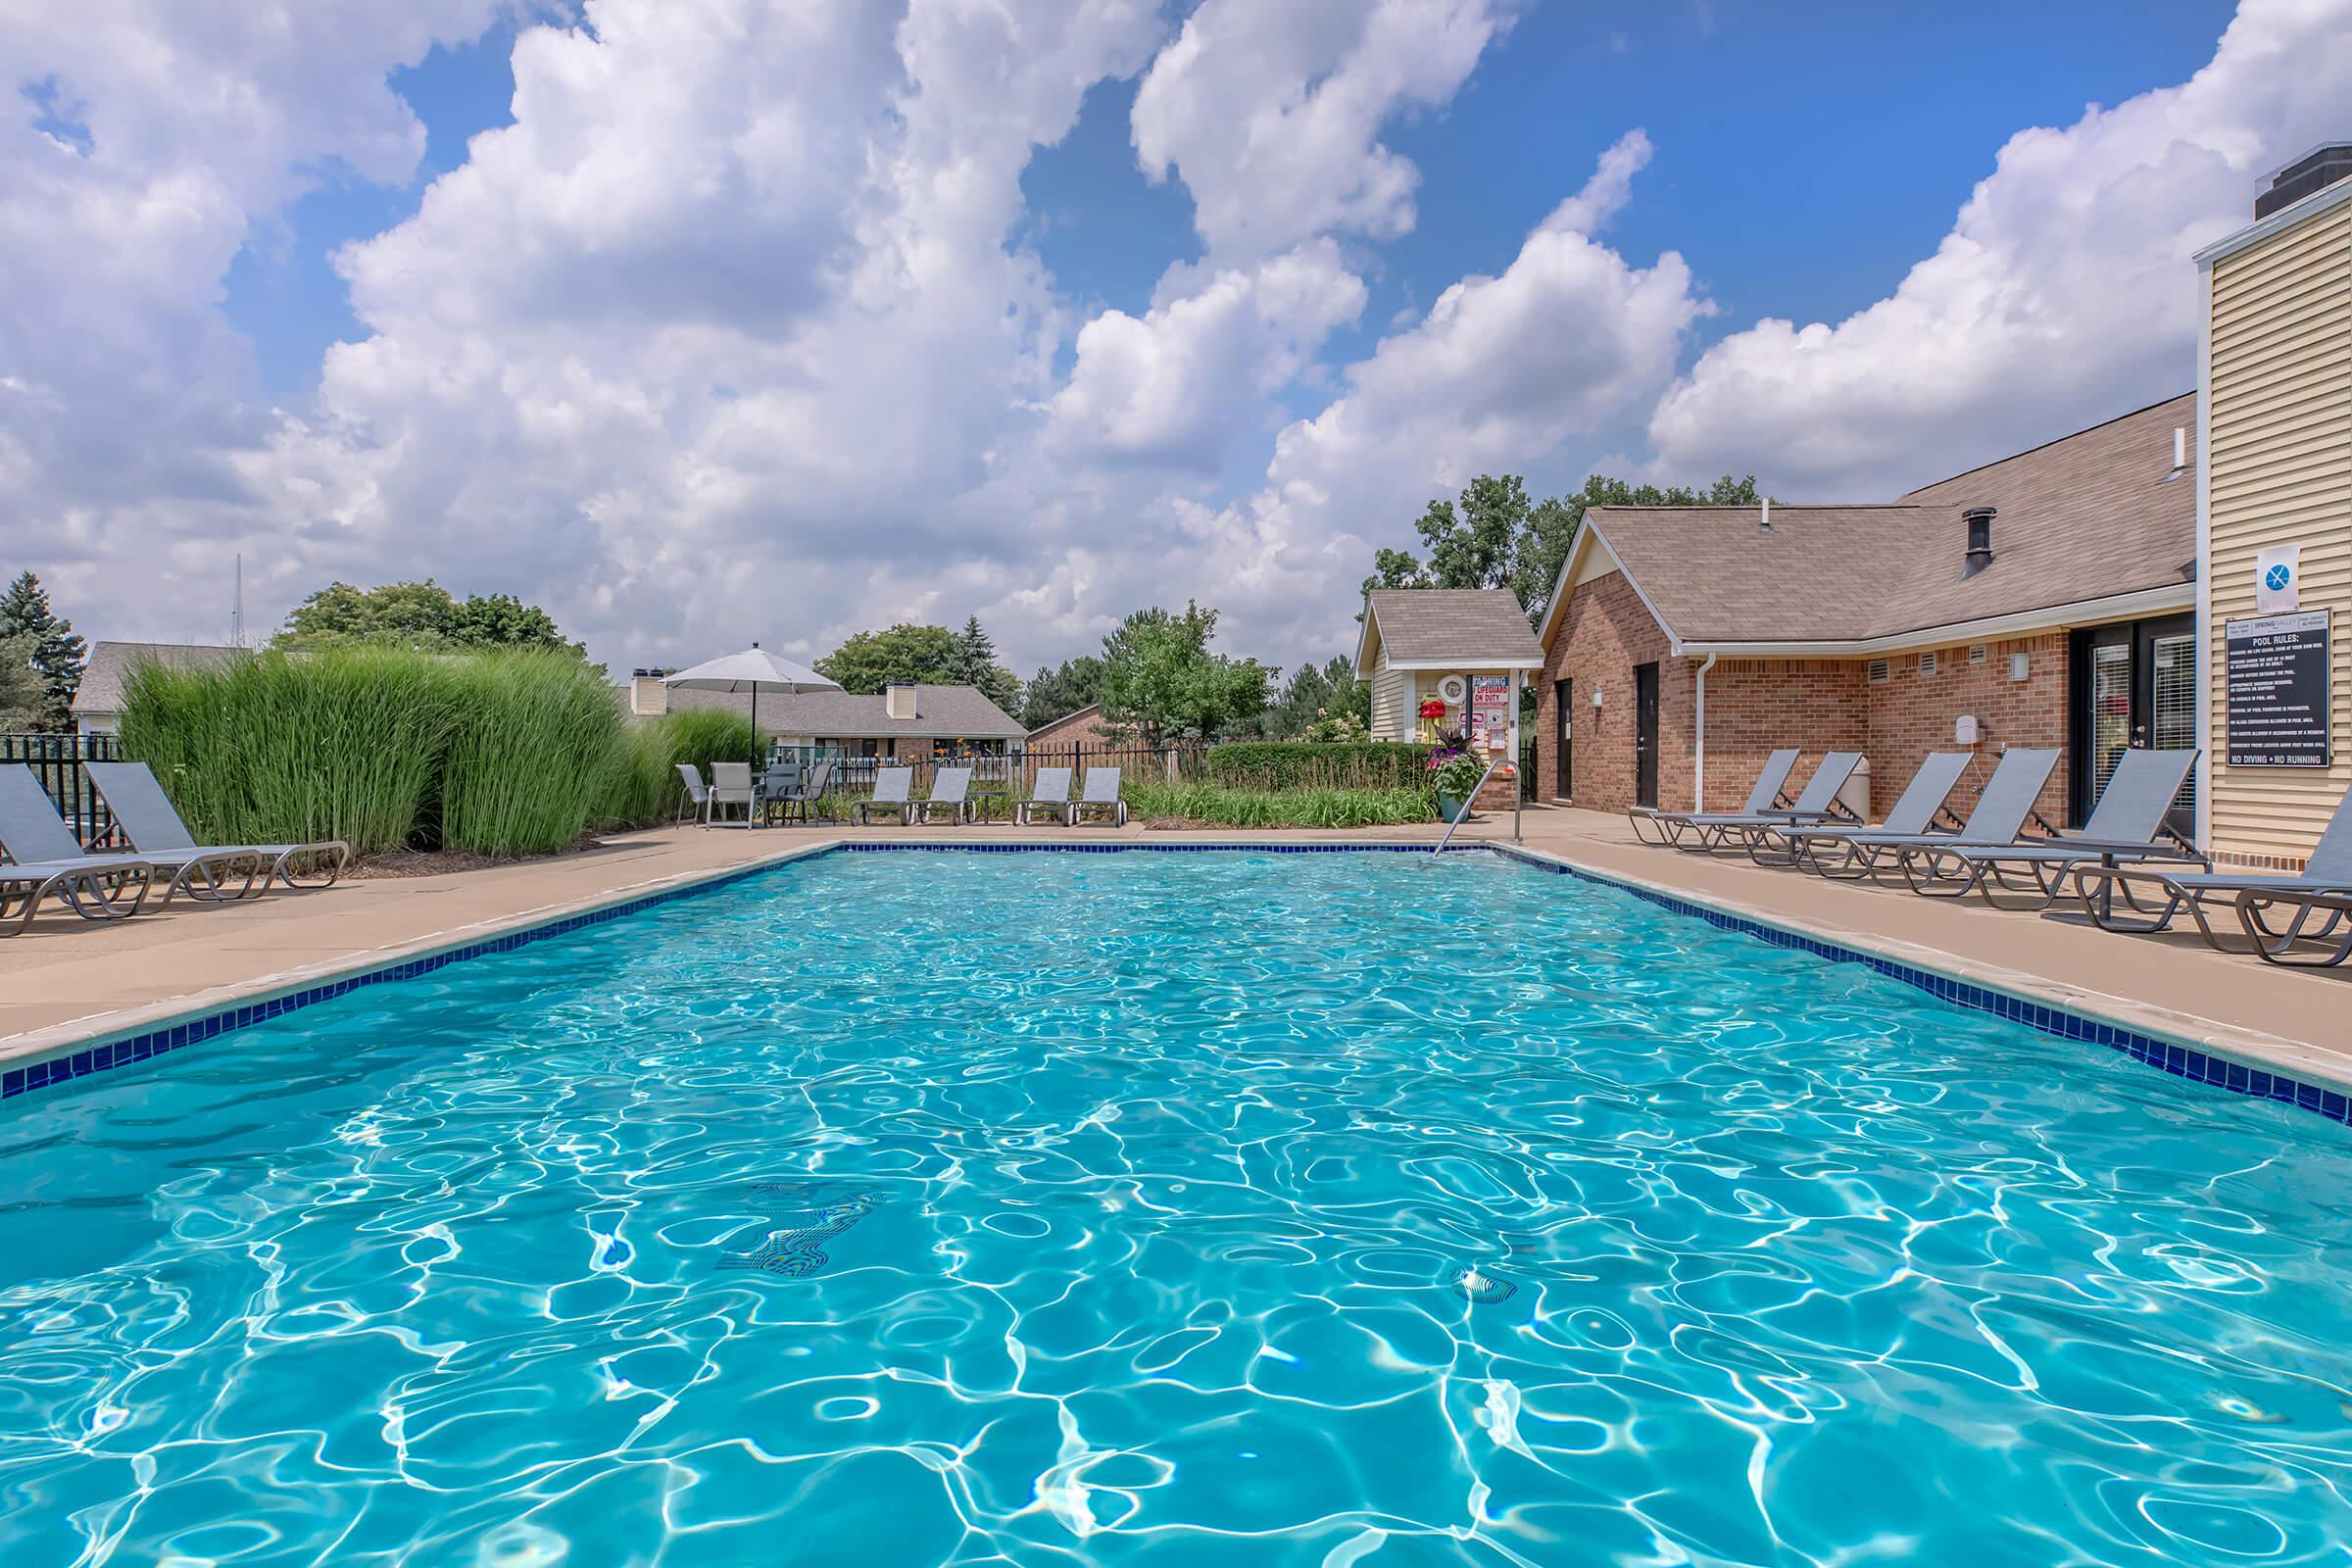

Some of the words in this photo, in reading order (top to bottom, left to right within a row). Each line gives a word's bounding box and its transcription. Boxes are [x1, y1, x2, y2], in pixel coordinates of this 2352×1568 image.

[2253, 636, 2271, 646] POOL
[2274, 634, 2299, 644] RULES:
[2232, 755, 2241, 764] NO
[2243, 755, 2267, 764] DIVING
[2274, 755, 2285, 764] NO
[2287, 755, 2321, 764] RUNNING
